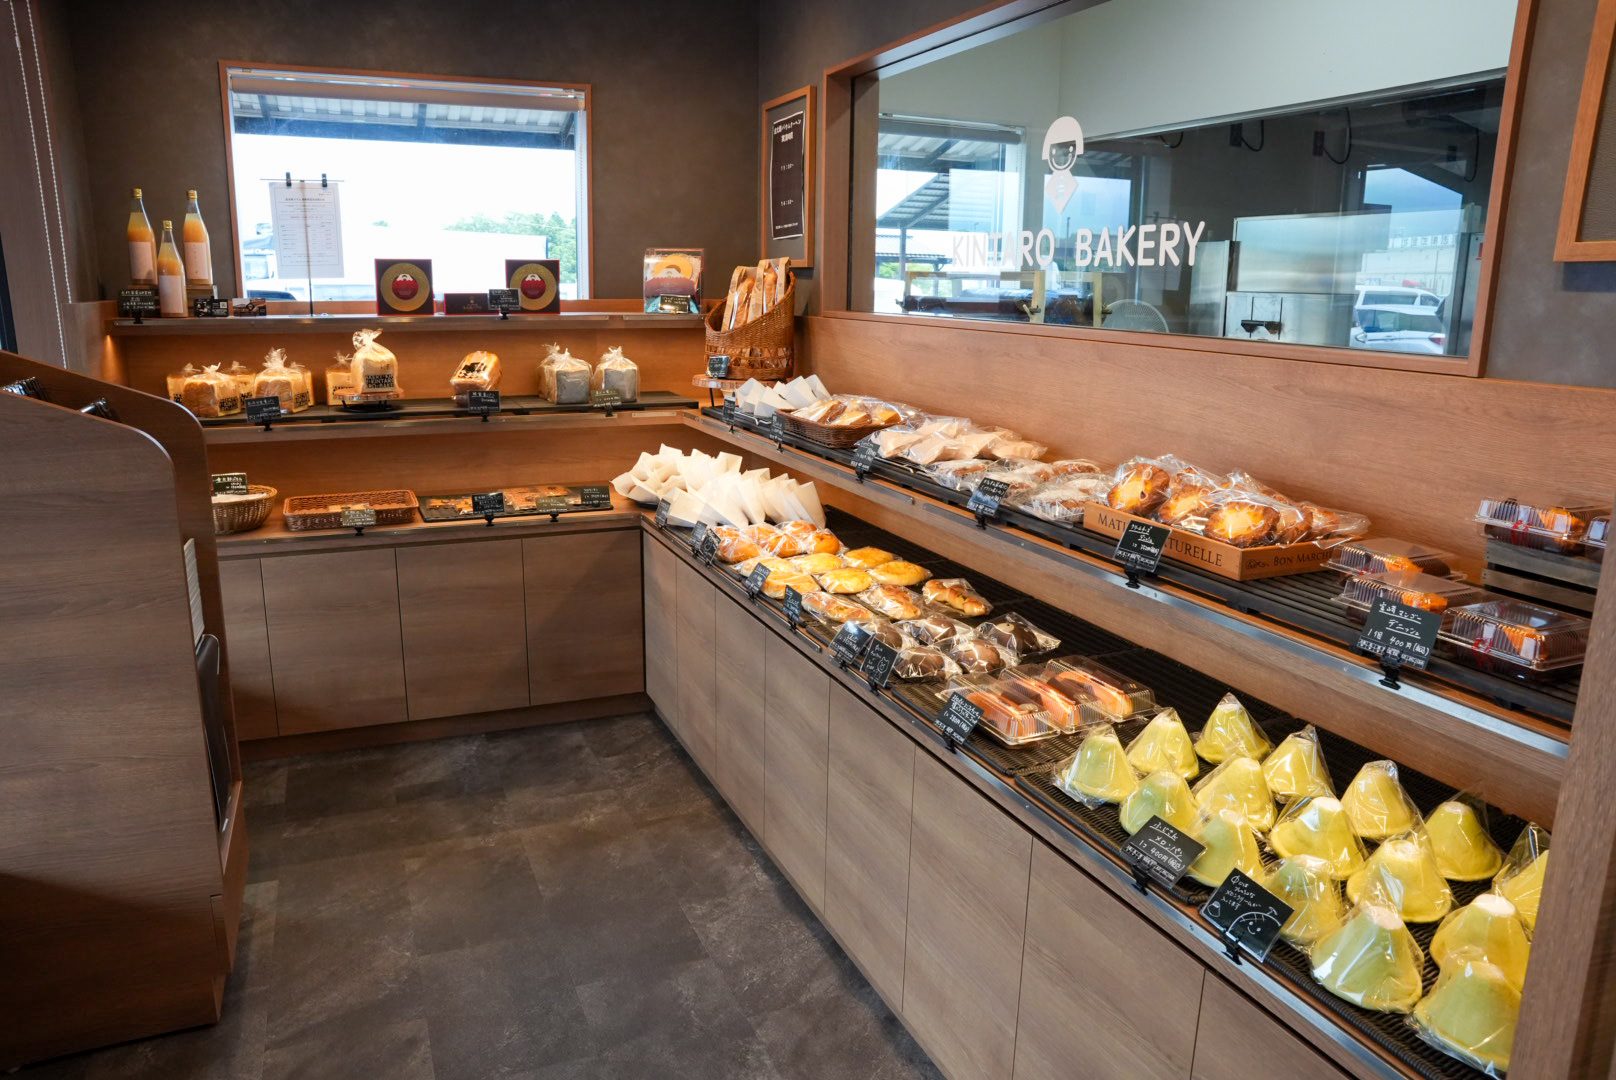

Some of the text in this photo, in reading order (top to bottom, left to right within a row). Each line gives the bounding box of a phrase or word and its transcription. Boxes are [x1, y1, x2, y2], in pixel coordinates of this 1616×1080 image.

[951, 220, 1206, 268] KINTARO BAKERY
[1164, 536, 1223, 567] TURELLE
[1273, 555, 1293, 567] BON
[1388, 619, 1420, 636] デニッシュ
[1155, 835, 1183, 857] メロンパン
